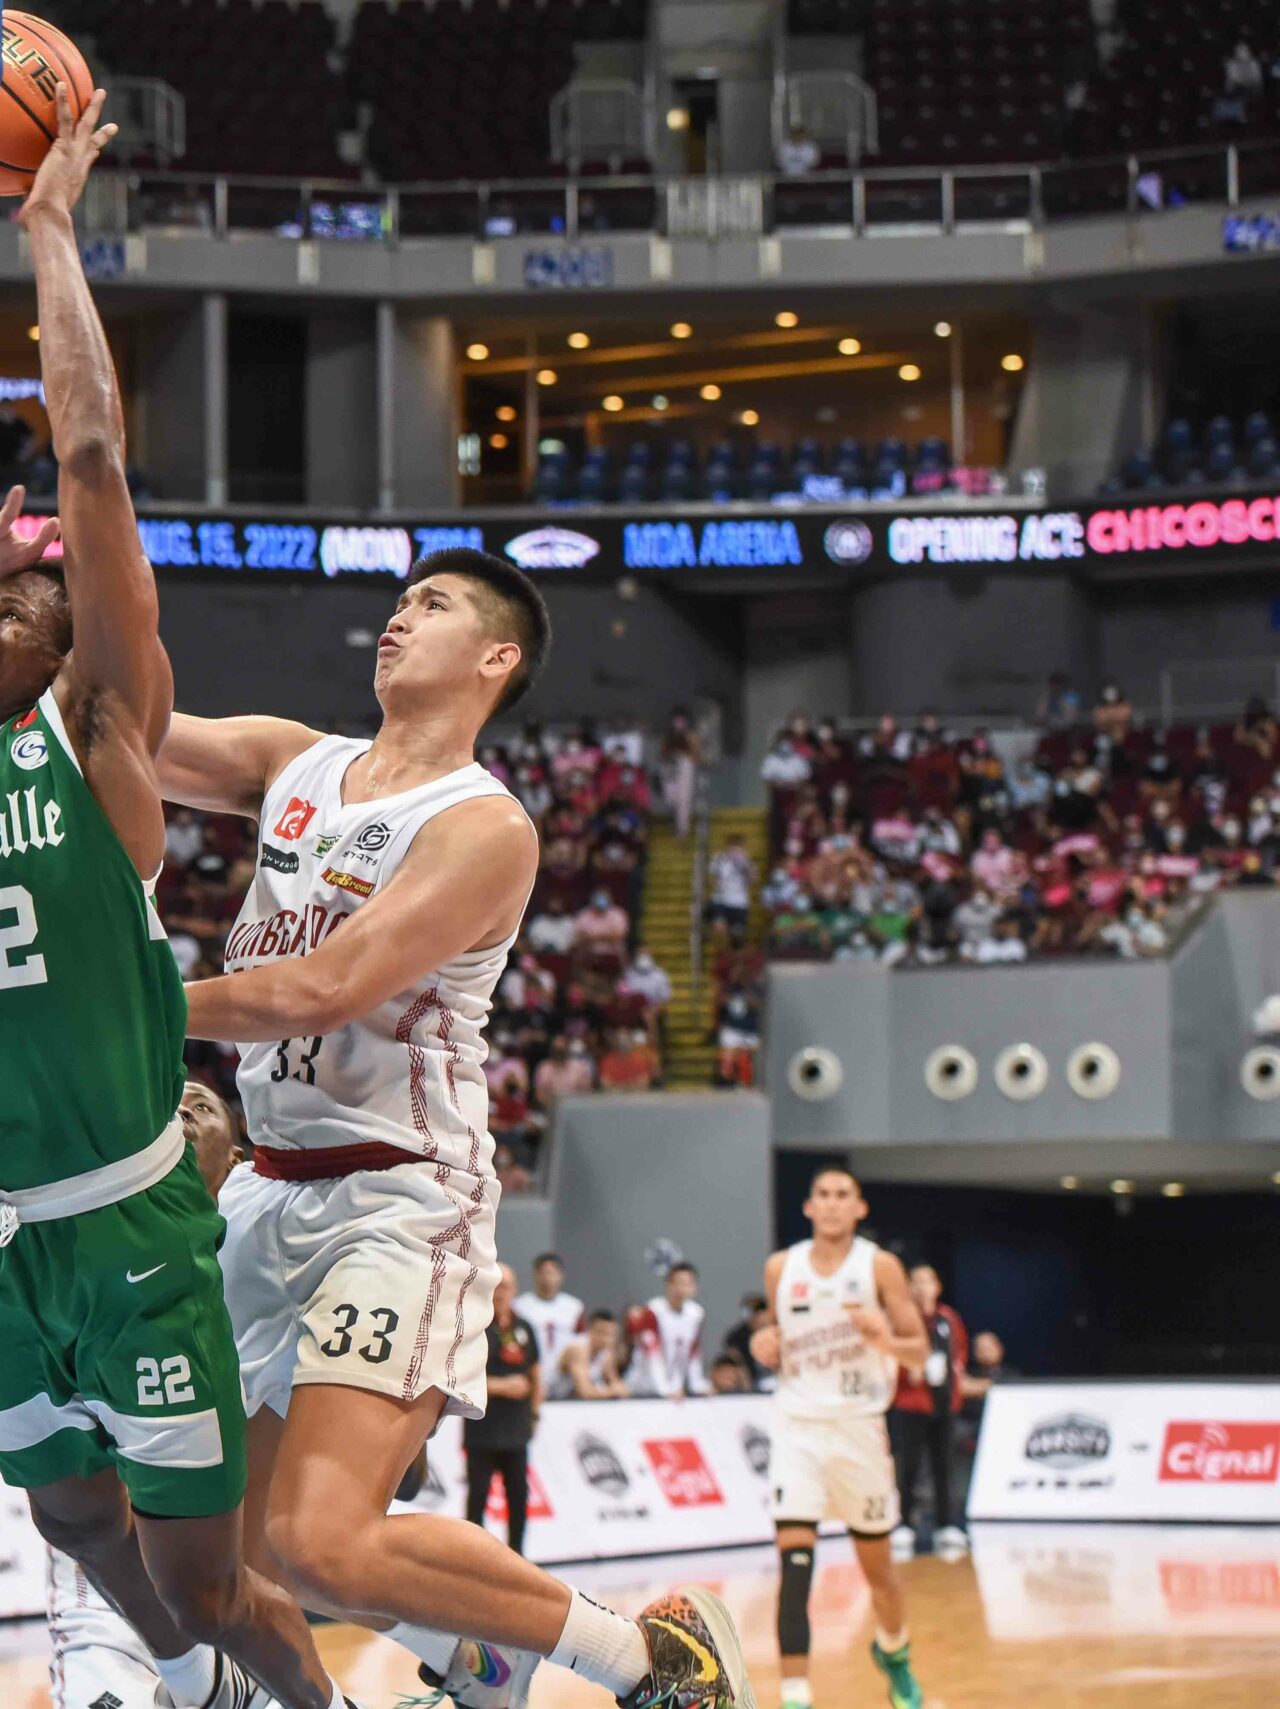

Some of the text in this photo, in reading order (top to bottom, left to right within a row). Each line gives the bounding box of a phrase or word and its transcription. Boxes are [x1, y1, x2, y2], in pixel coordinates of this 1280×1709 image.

[243, 523, 318, 571] 2022
[698, 519, 803, 567] ARENA
[888, 515, 1018, 564] OPENING
[343, 850, 379, 867] STATS
[320, 1303, 400, 1364] 33
[136, 1354, 195, 1406] 22
[1167, 1440, 1274, 1482] Cignal
